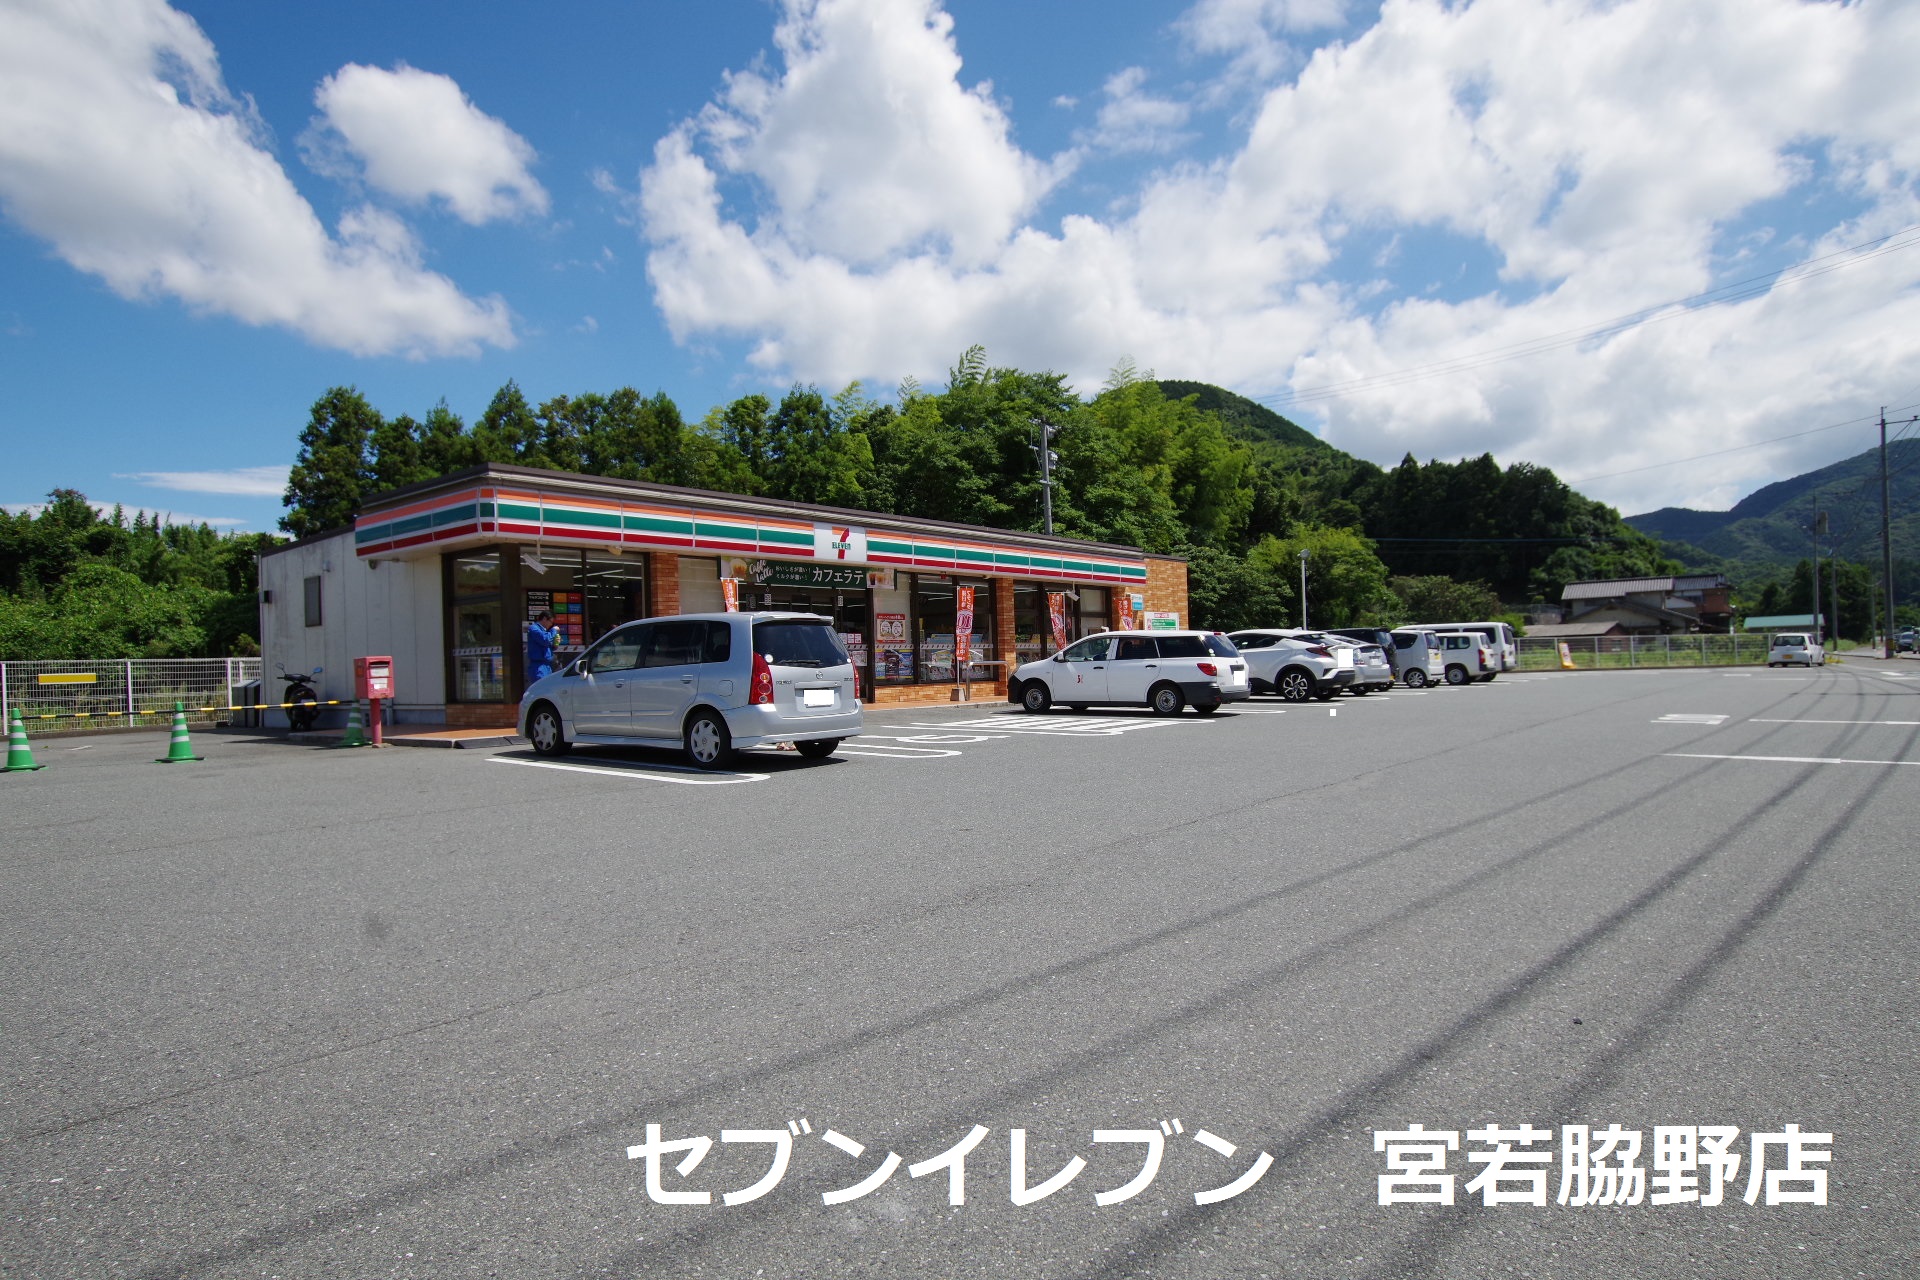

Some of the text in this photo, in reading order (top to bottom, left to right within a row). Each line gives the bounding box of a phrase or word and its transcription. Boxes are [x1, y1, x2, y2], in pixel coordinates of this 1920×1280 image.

[812, 566, 864, 584] カフェラテ
